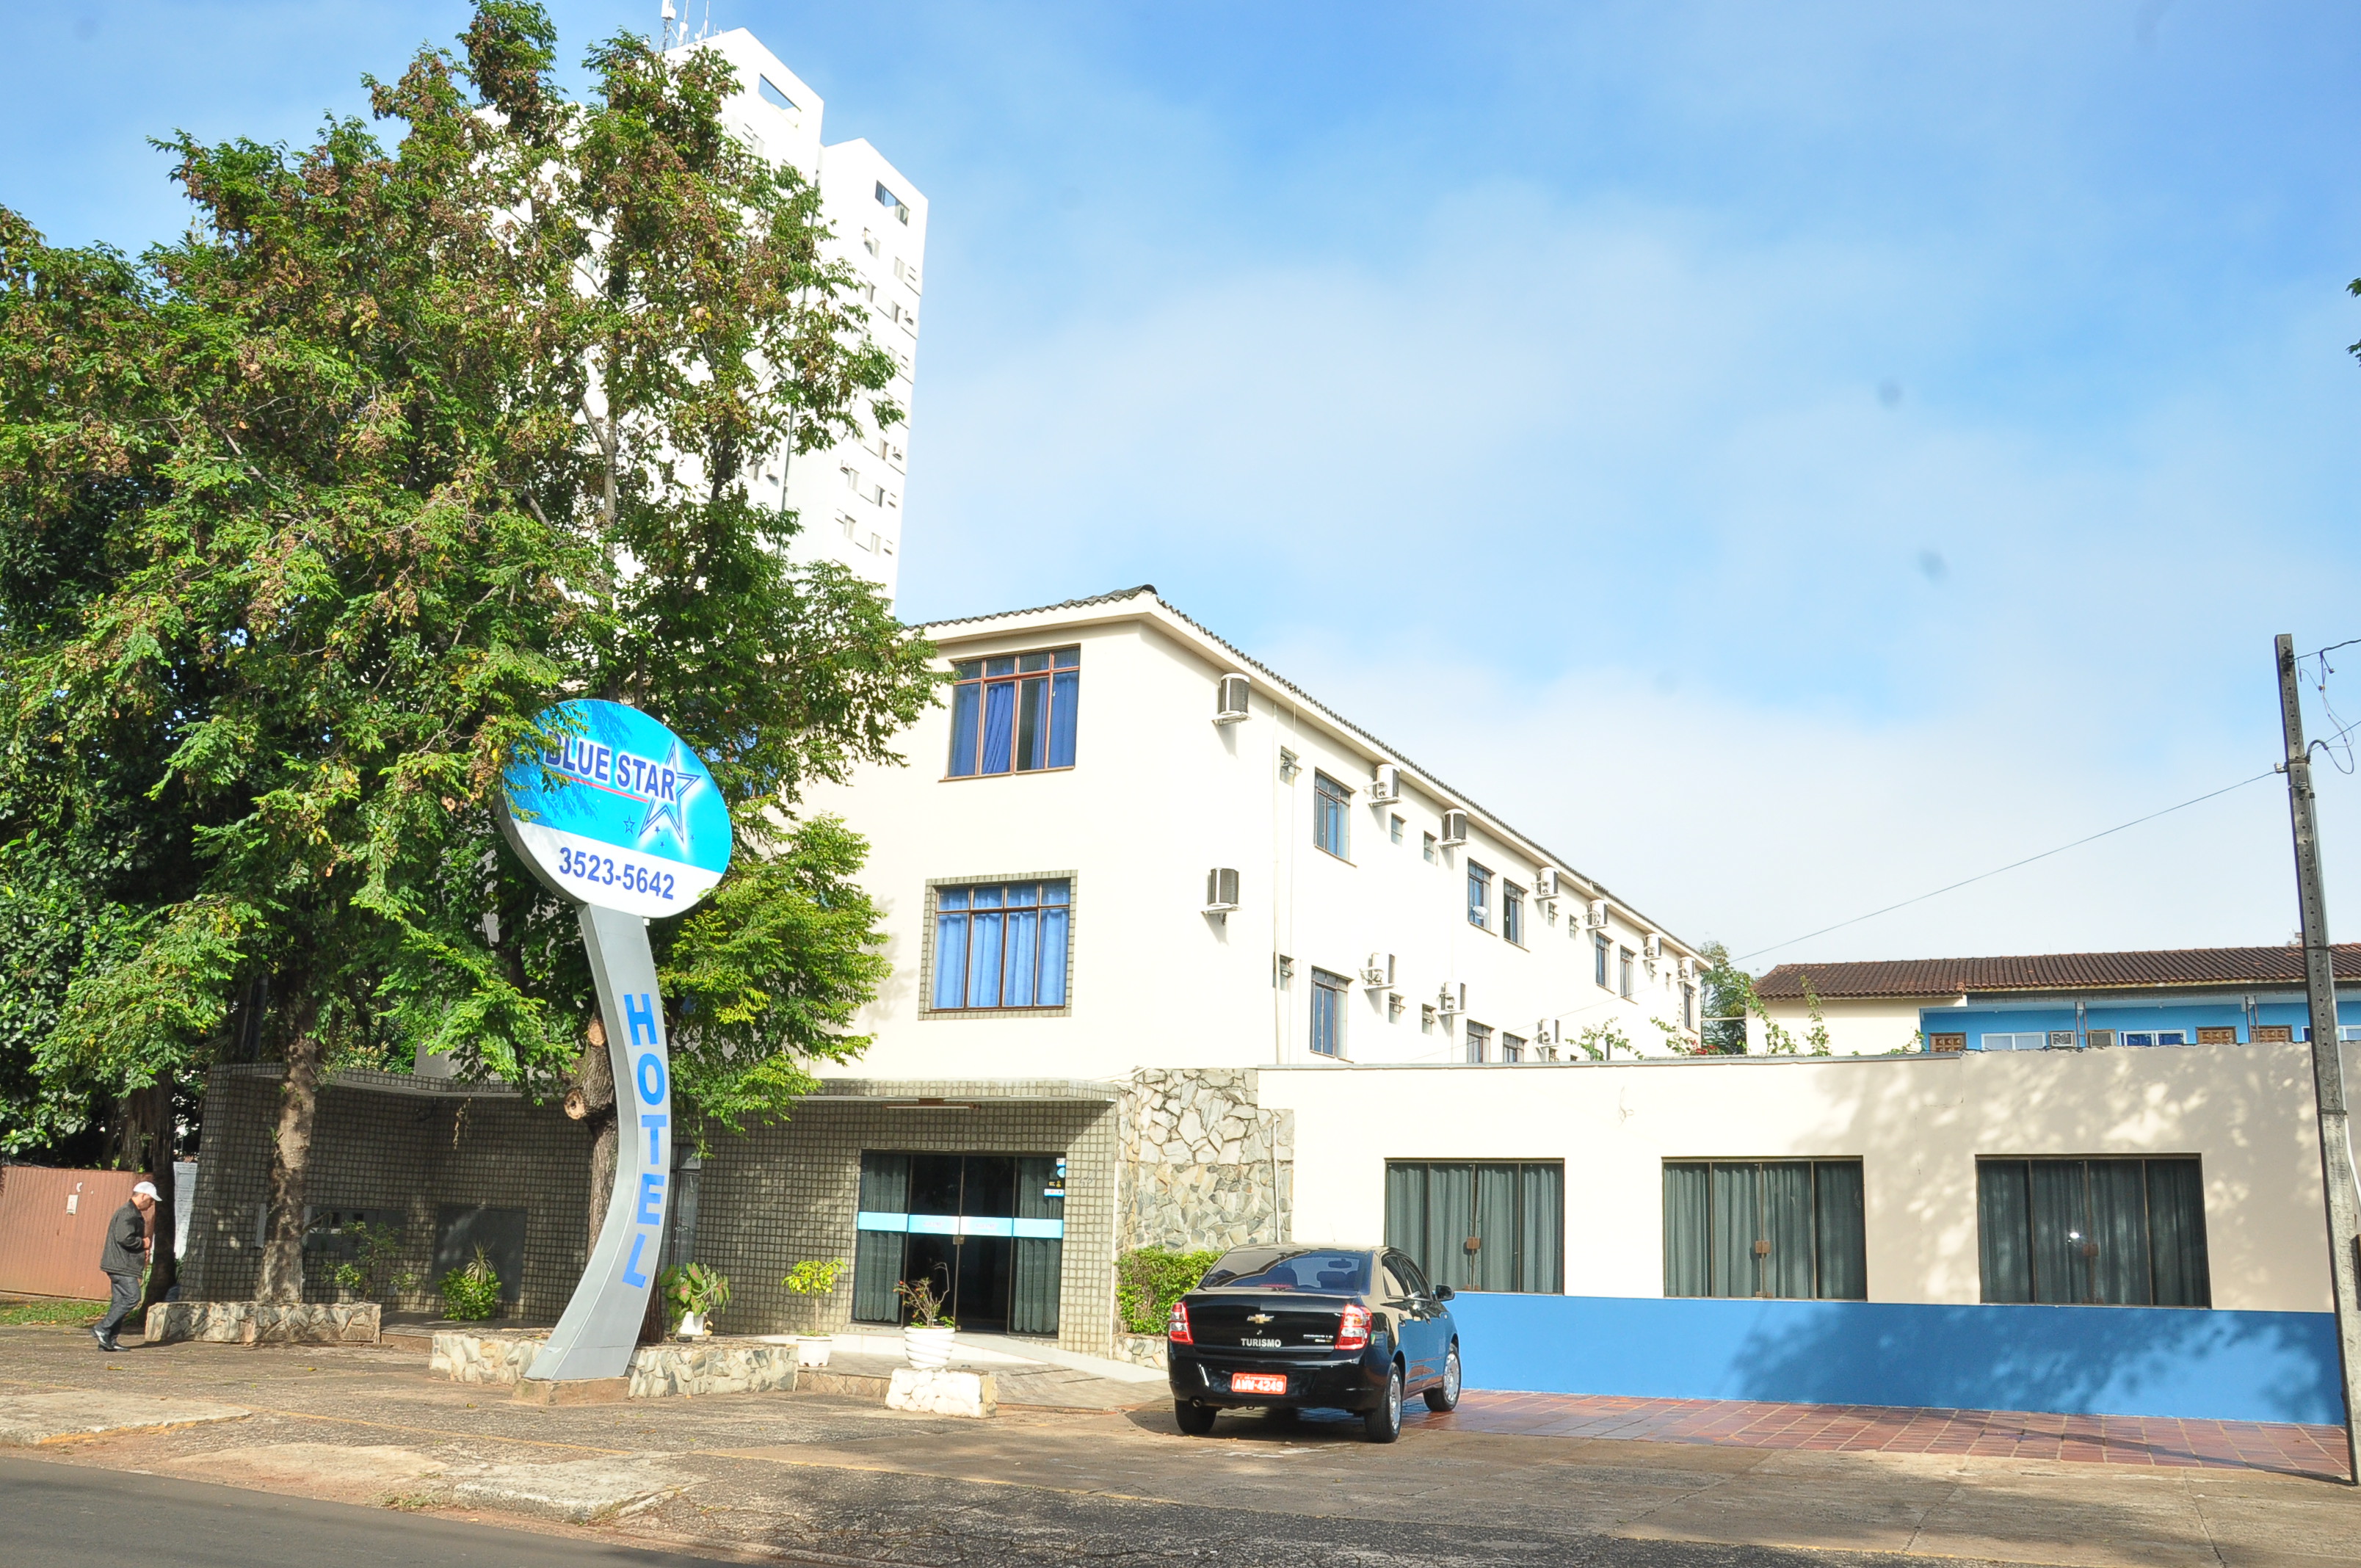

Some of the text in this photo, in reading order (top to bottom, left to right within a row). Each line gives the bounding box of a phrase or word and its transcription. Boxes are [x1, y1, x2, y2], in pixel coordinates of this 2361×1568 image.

[545, 730, 675, 802] BLUE STAR
[559, 846, 675, 900] 3523-5642
[623, 993, 667, 1288] HOTEL
[1240, 1337, 1282, 1348] TURISMO
